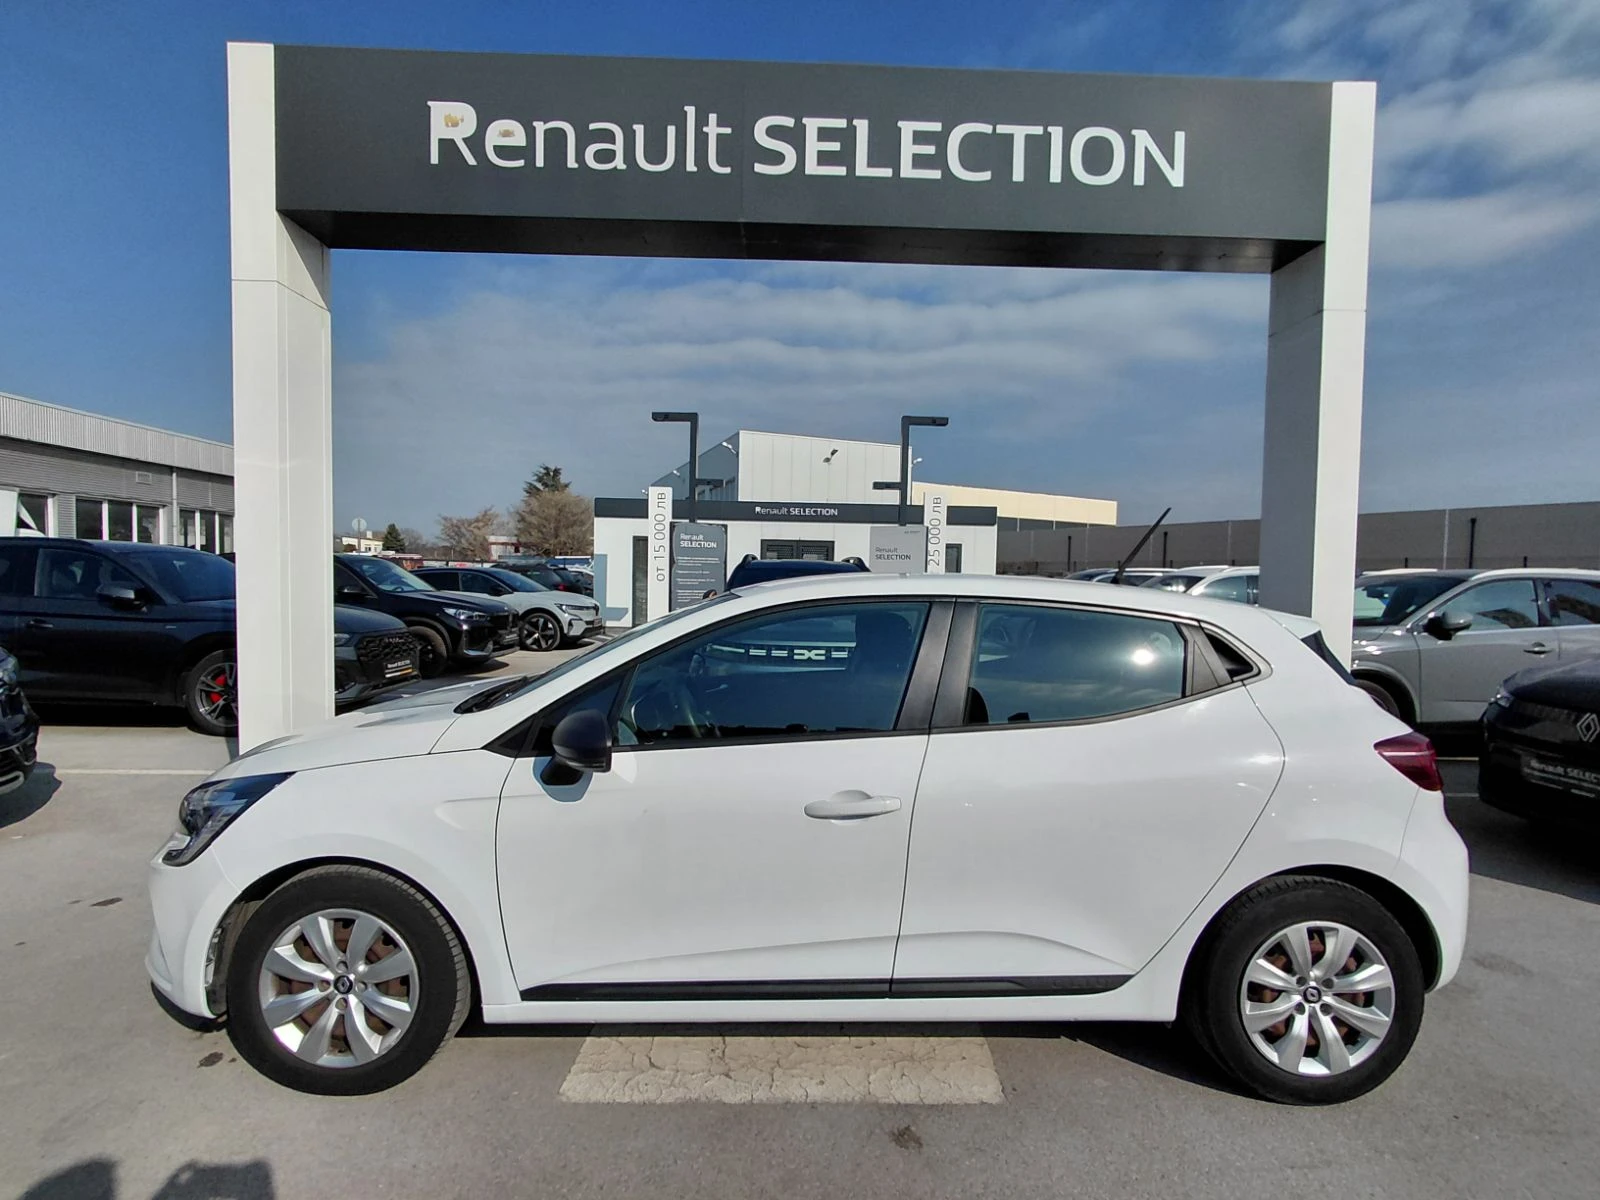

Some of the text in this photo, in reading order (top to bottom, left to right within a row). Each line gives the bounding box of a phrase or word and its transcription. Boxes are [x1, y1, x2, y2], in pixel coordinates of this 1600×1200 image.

[427, 100, 1186, 188] Renault SELECTION
[755, 506, 838, 516] Renault SELECTION
[680, 533, 704, 541] Renault
[680, 540, 717, 549] SELECTION
[875, 553, 912, 561] SELECTION
